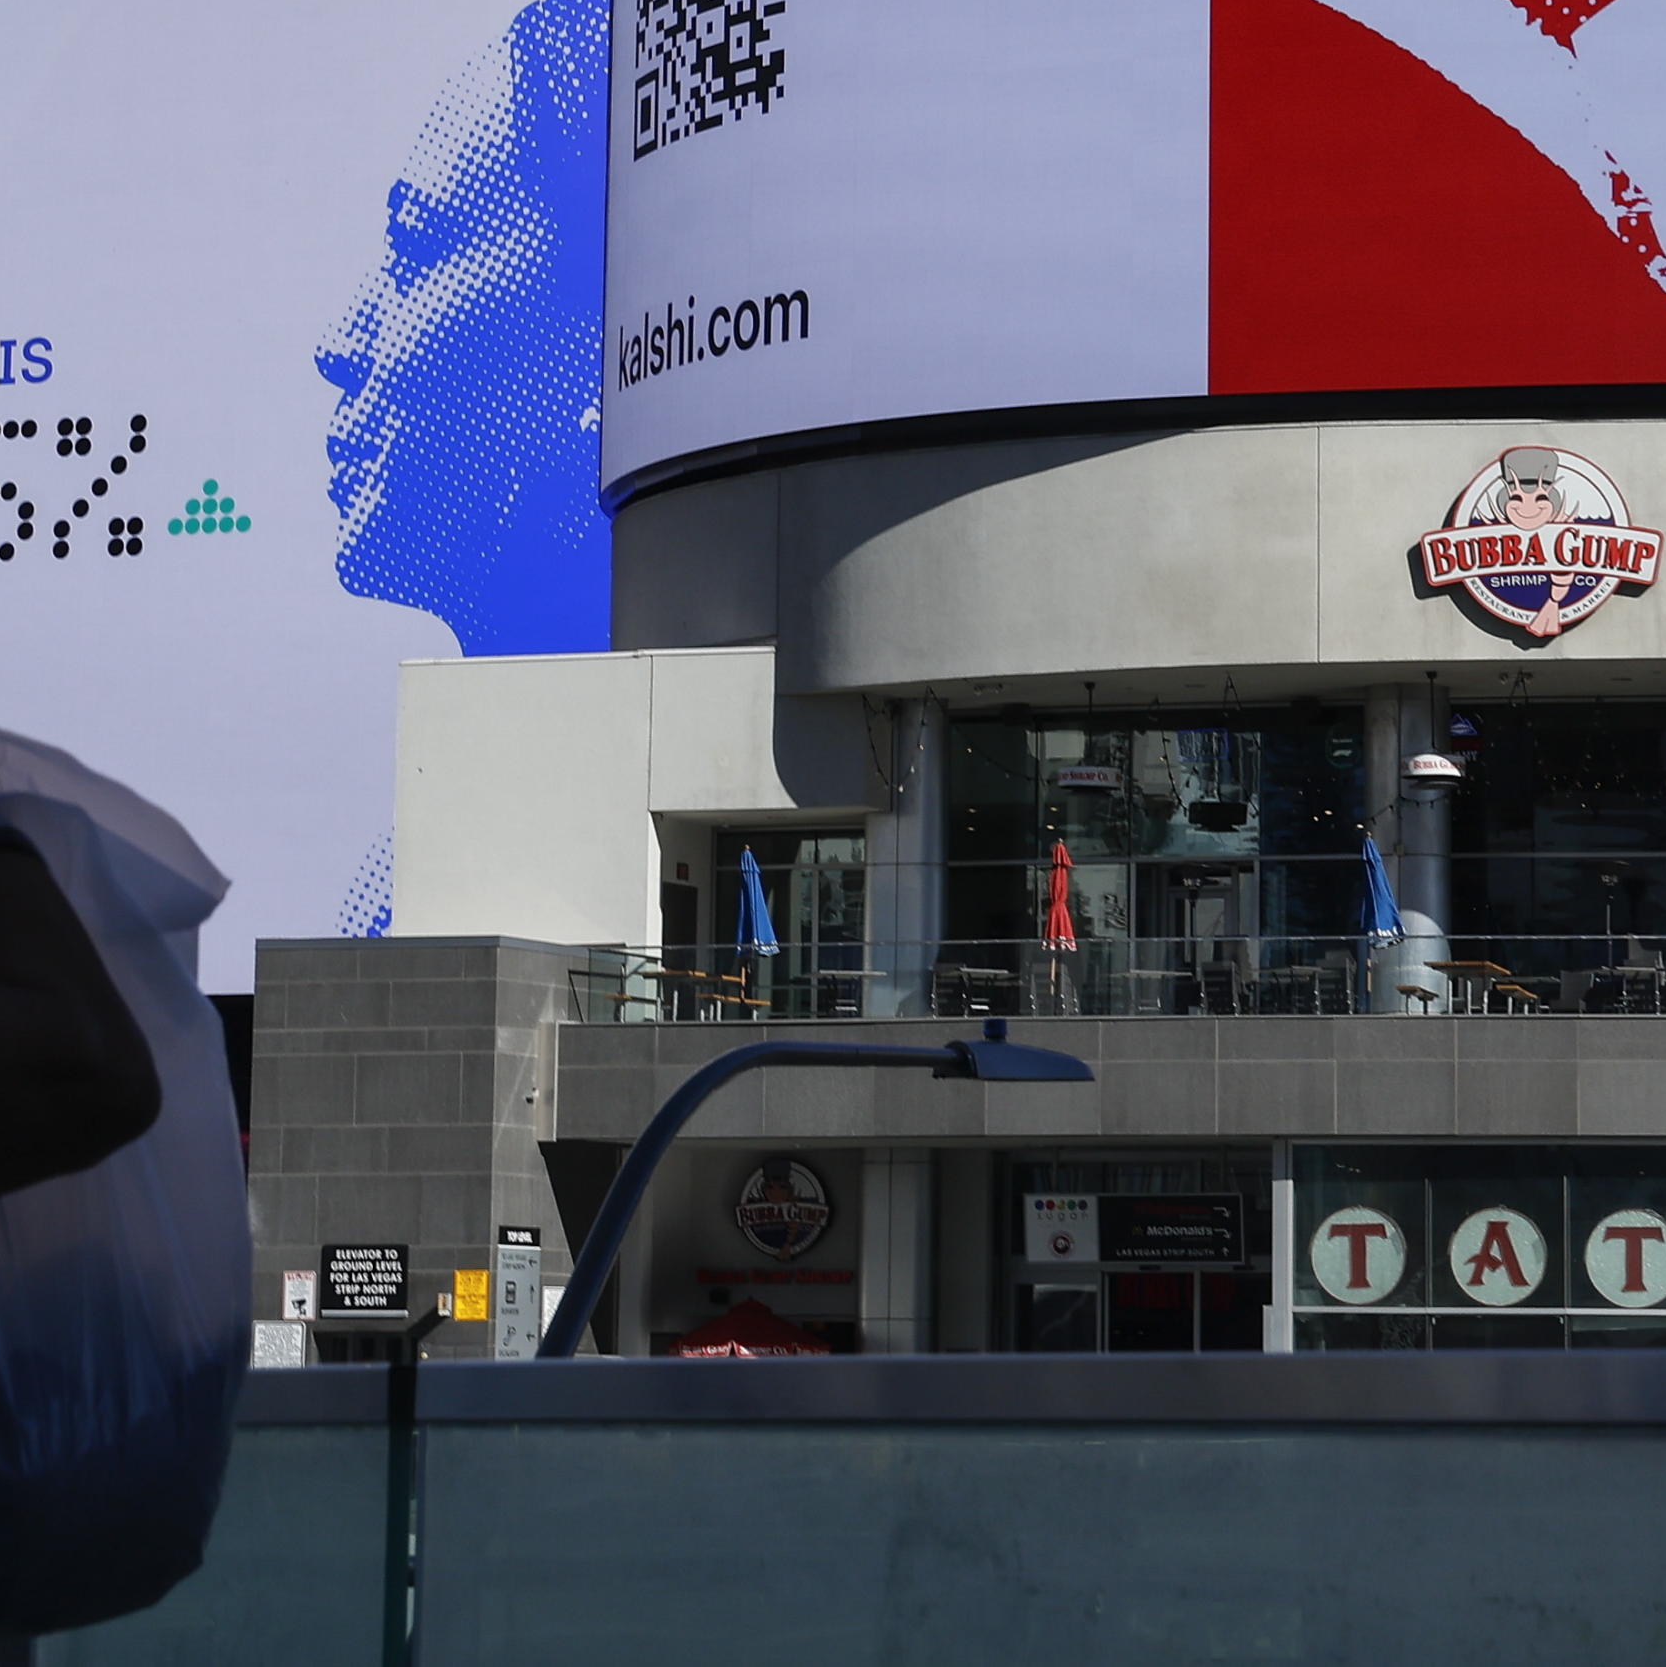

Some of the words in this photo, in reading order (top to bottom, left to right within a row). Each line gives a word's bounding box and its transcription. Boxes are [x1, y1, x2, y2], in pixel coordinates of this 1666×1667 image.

[618, 289, 809, 392] kalshi.com
[1429, 532, 1548, 577] BUBBA
[1555, 527, 1656, 574] GUMP
[1490, 575, 1547, 588] SHRIMP
[1469, 579, 1532, 623] RESTAURANT
[1572, 582, 1612, 618] MARKET
[1147, 1225, 1213, 1236] McDonald's
[336, 1249, 383, 1260] ELEVATOR
[384, 1249, 399, 1260] TO
[330, 1261, 374, 1272] GROUND
[376, 1261, 403, 1272] LEVEL
[329, 1272, 349, 1283] FOR
[352, 1272, 369, 1283] LAS
[371, 1272, 403, 1284] VEGAS
[335, 1284, 361, 1295] STRIP
[363, 1284, 397, 1295] NORTH
[344, 1296, 352, 1307] &
[354, 1296, 388, 1307] SOUTH
